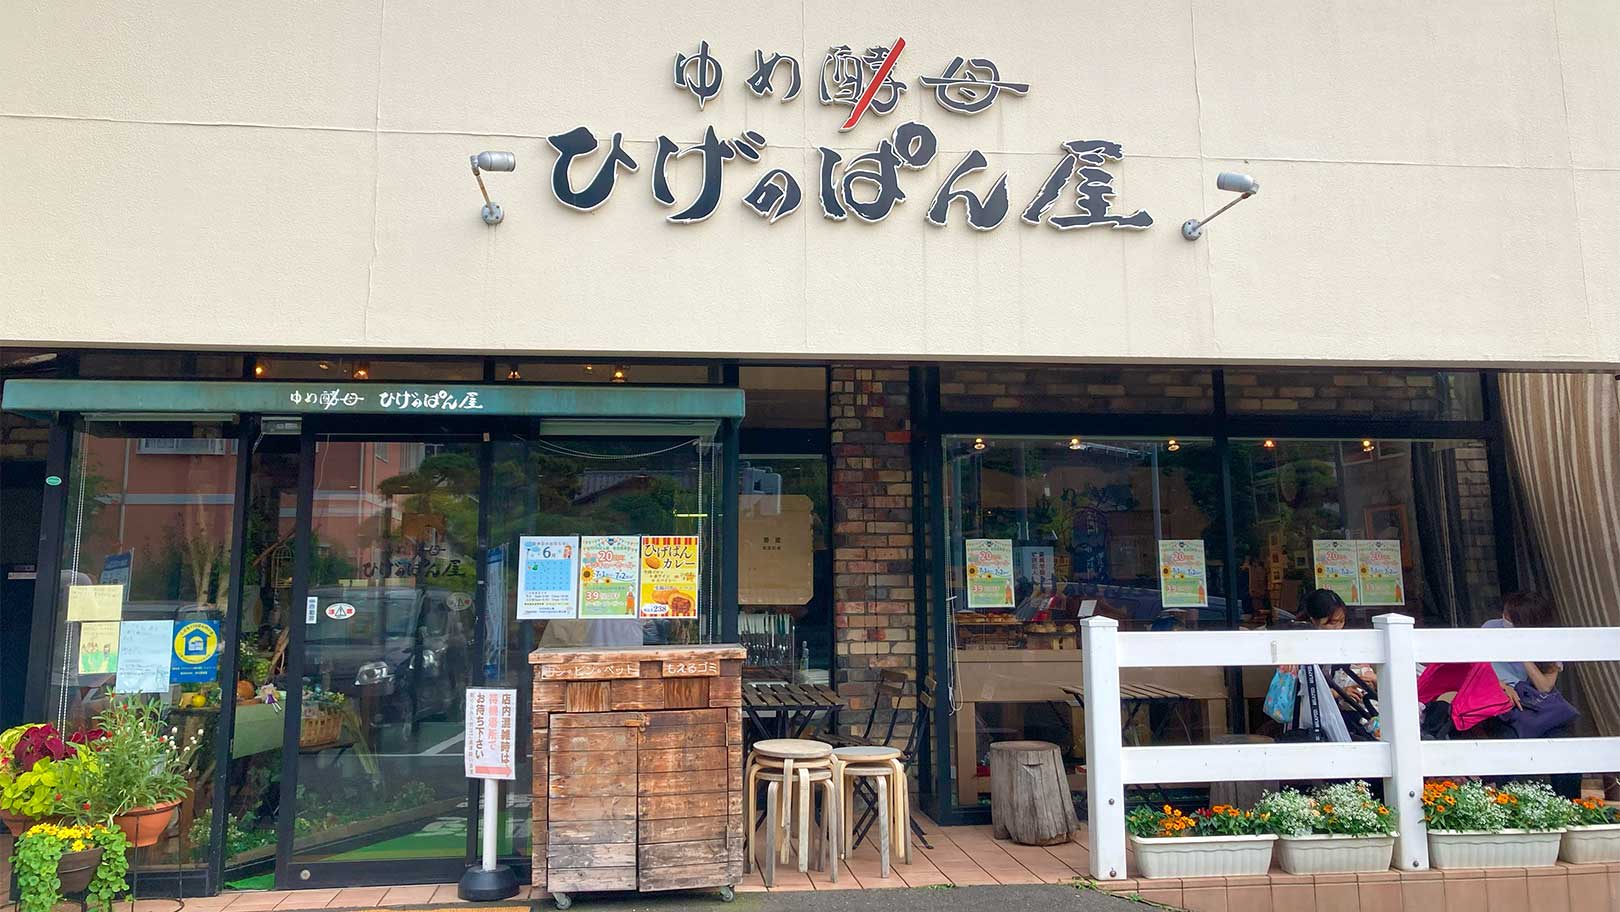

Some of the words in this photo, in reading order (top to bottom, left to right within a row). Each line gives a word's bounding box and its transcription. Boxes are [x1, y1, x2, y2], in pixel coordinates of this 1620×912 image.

[672, 37, 1030, 133] ゆめ酵母
[545, 120, 1154, 232] ひげのぱん屋
[290, 388, 365, 410] ゆめ酵母
[378, 389, 484, 410] ひげのぱん屋
[663, 558, 696, 569] カレー
[668, 661, 717, 674] もえるゴミ
[475, 692, 486, 760] お待ち下さい
